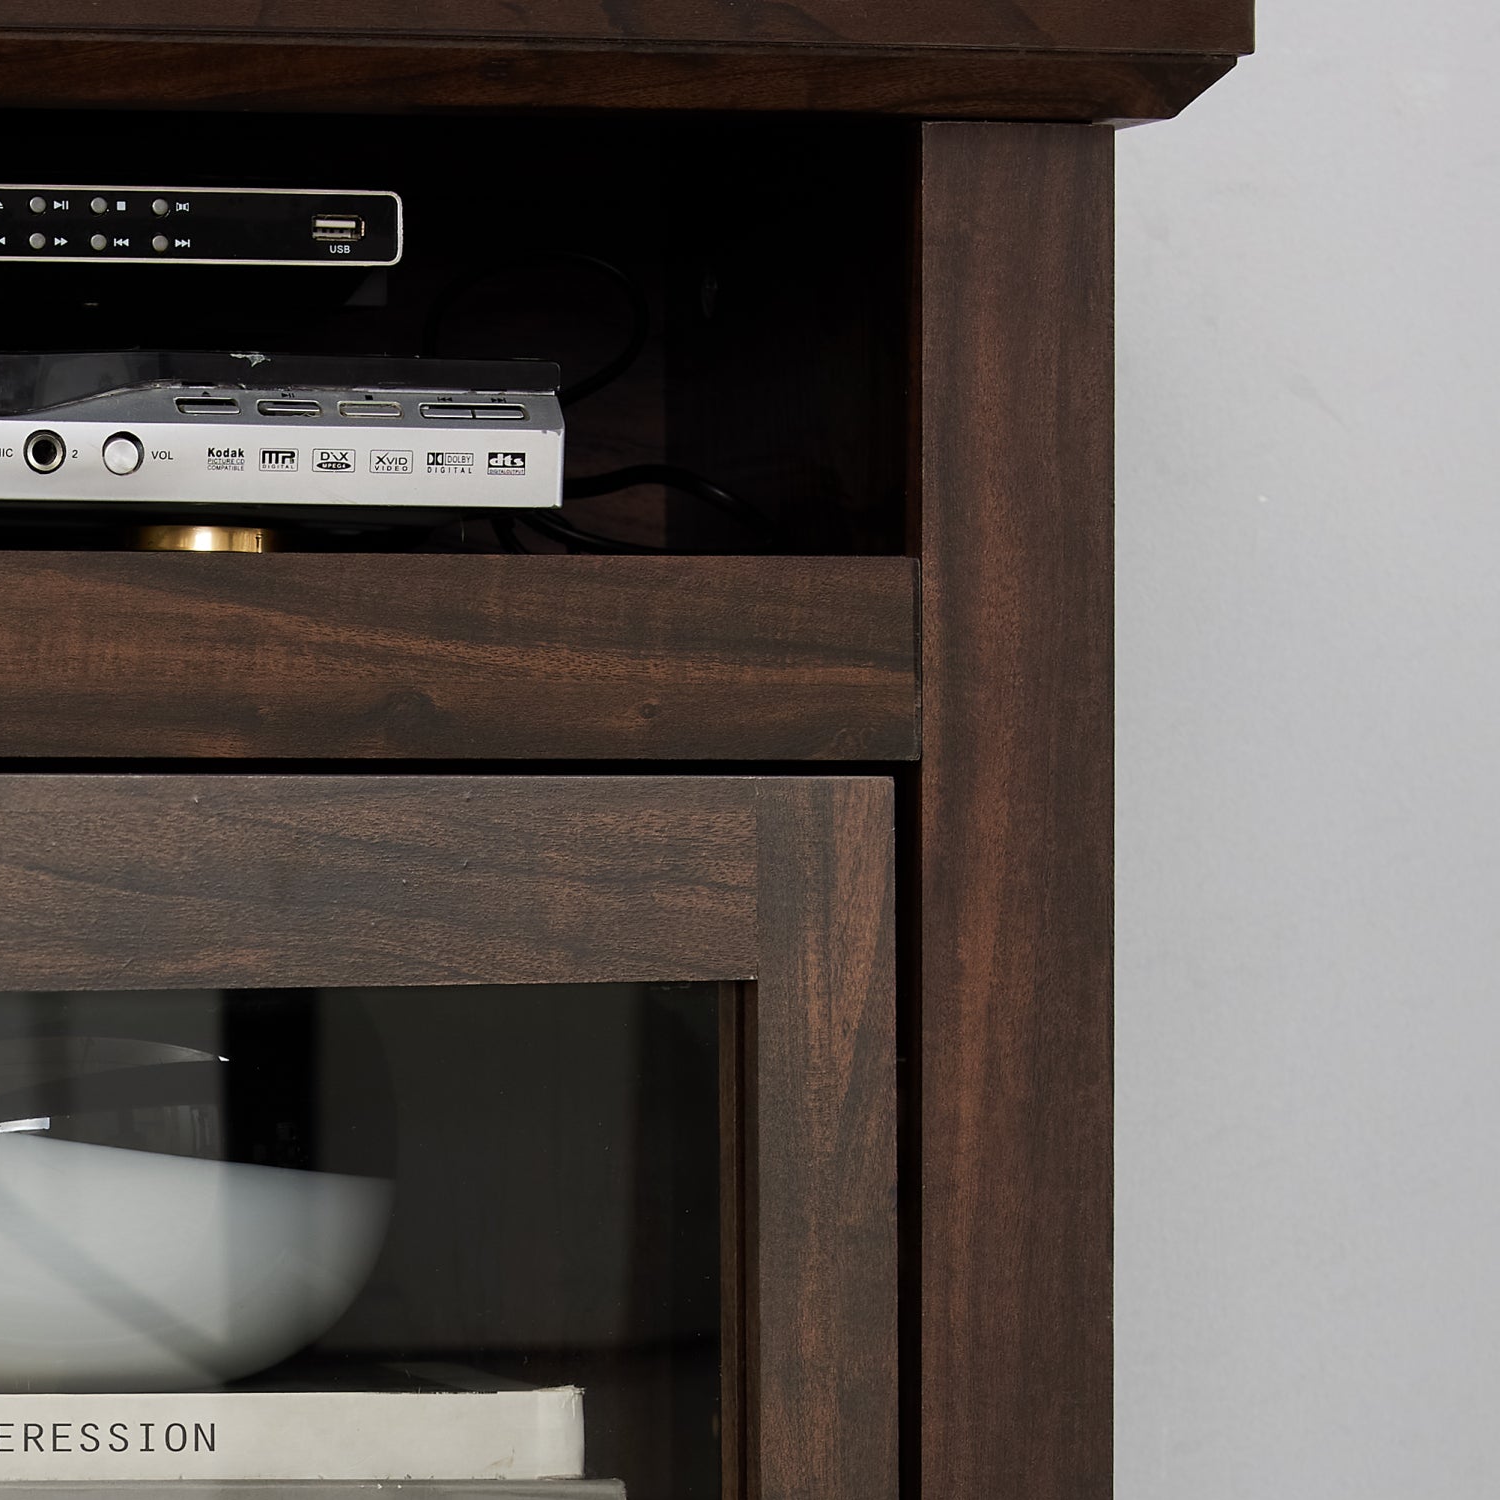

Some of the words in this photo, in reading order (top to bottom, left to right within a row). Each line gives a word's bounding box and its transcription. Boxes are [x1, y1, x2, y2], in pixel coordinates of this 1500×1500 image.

[329, 244, 351, 254] USB
[71, 449, 78, 459] 2
[151, 450, 174, 461] VOL
[208, 448, 245, 457] Kodak
[489, 454, 524, 466] dts
